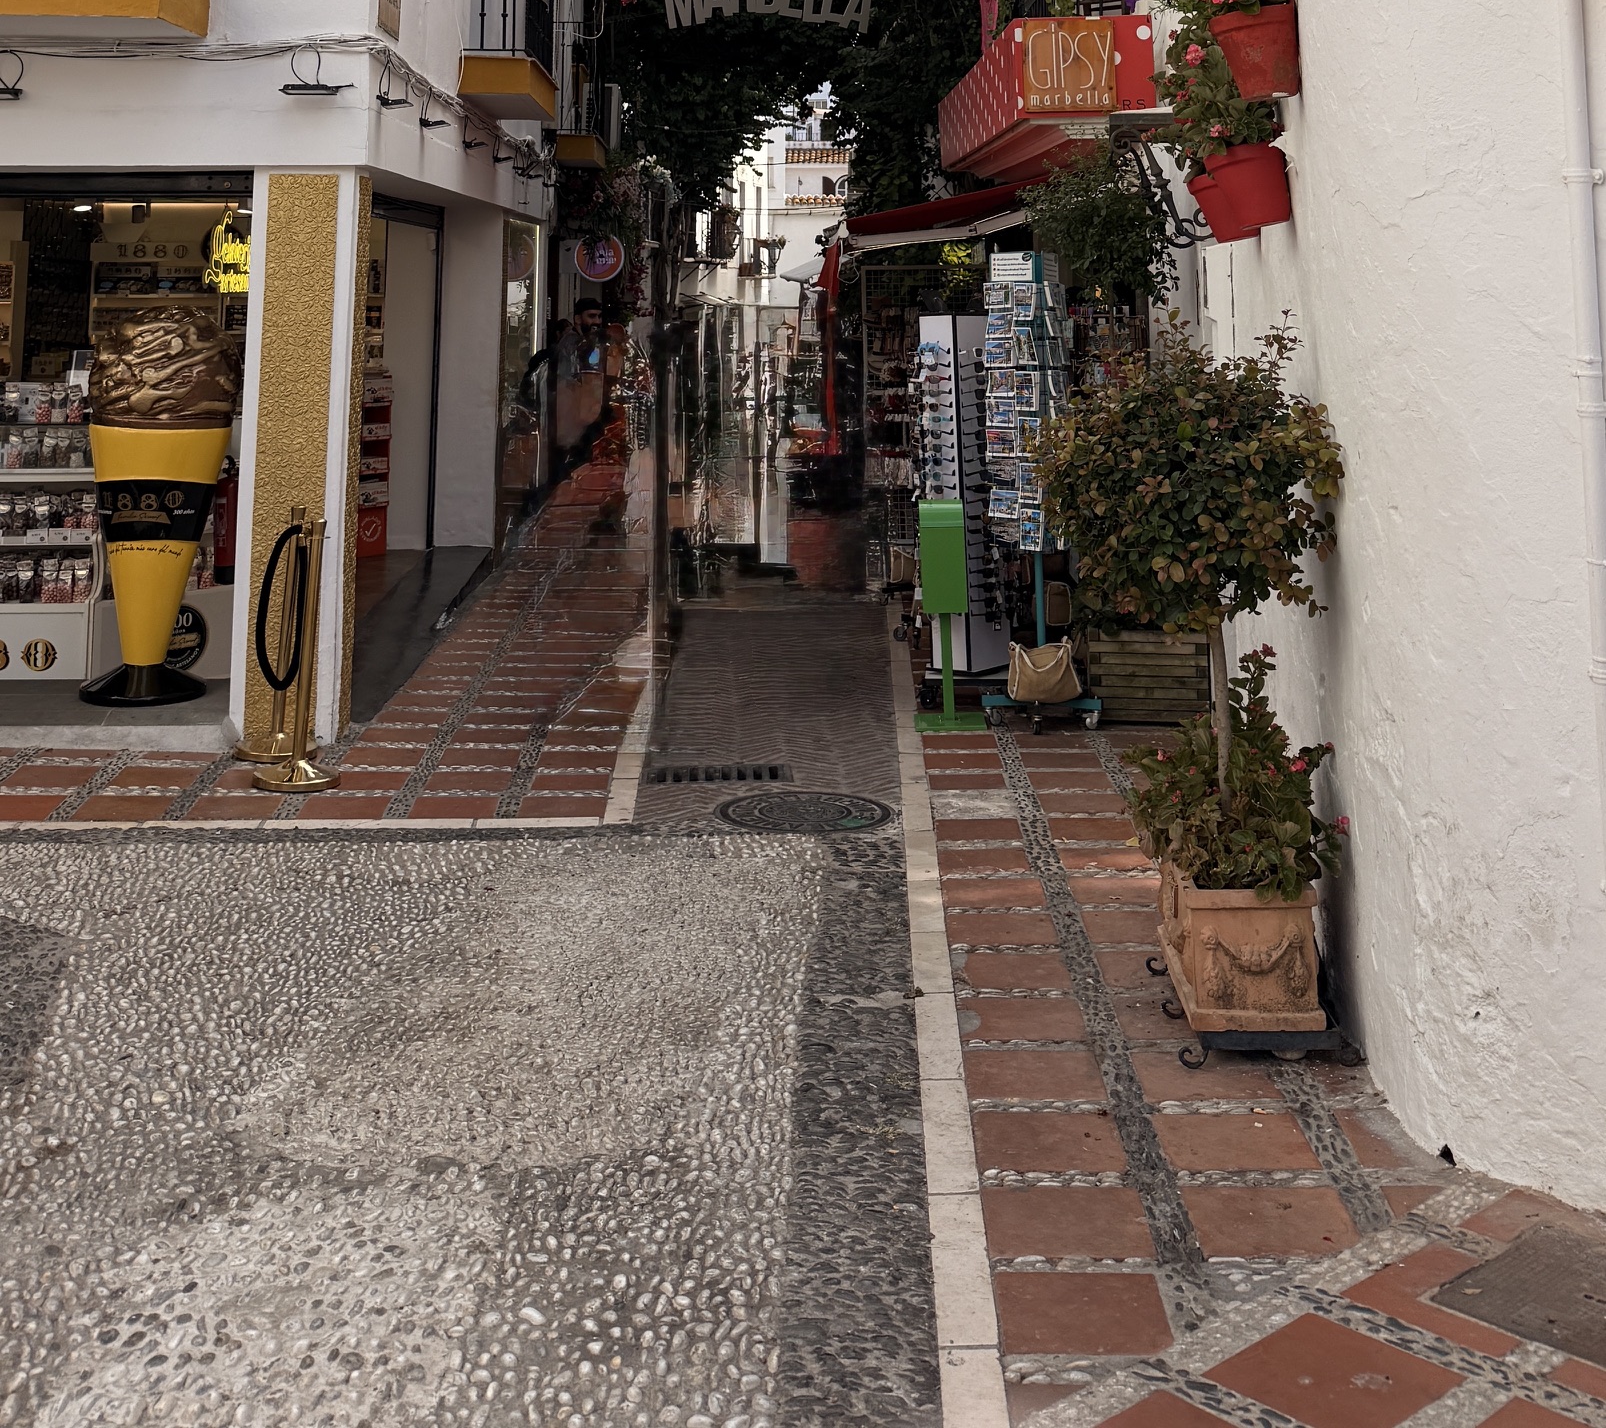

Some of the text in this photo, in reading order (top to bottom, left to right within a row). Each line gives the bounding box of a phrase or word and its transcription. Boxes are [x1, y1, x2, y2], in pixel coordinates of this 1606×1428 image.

[1029, 90, 1110, 107] marbella
[117, 243, 189, 259] 1880
[101, 490, 185, 511] 1880
